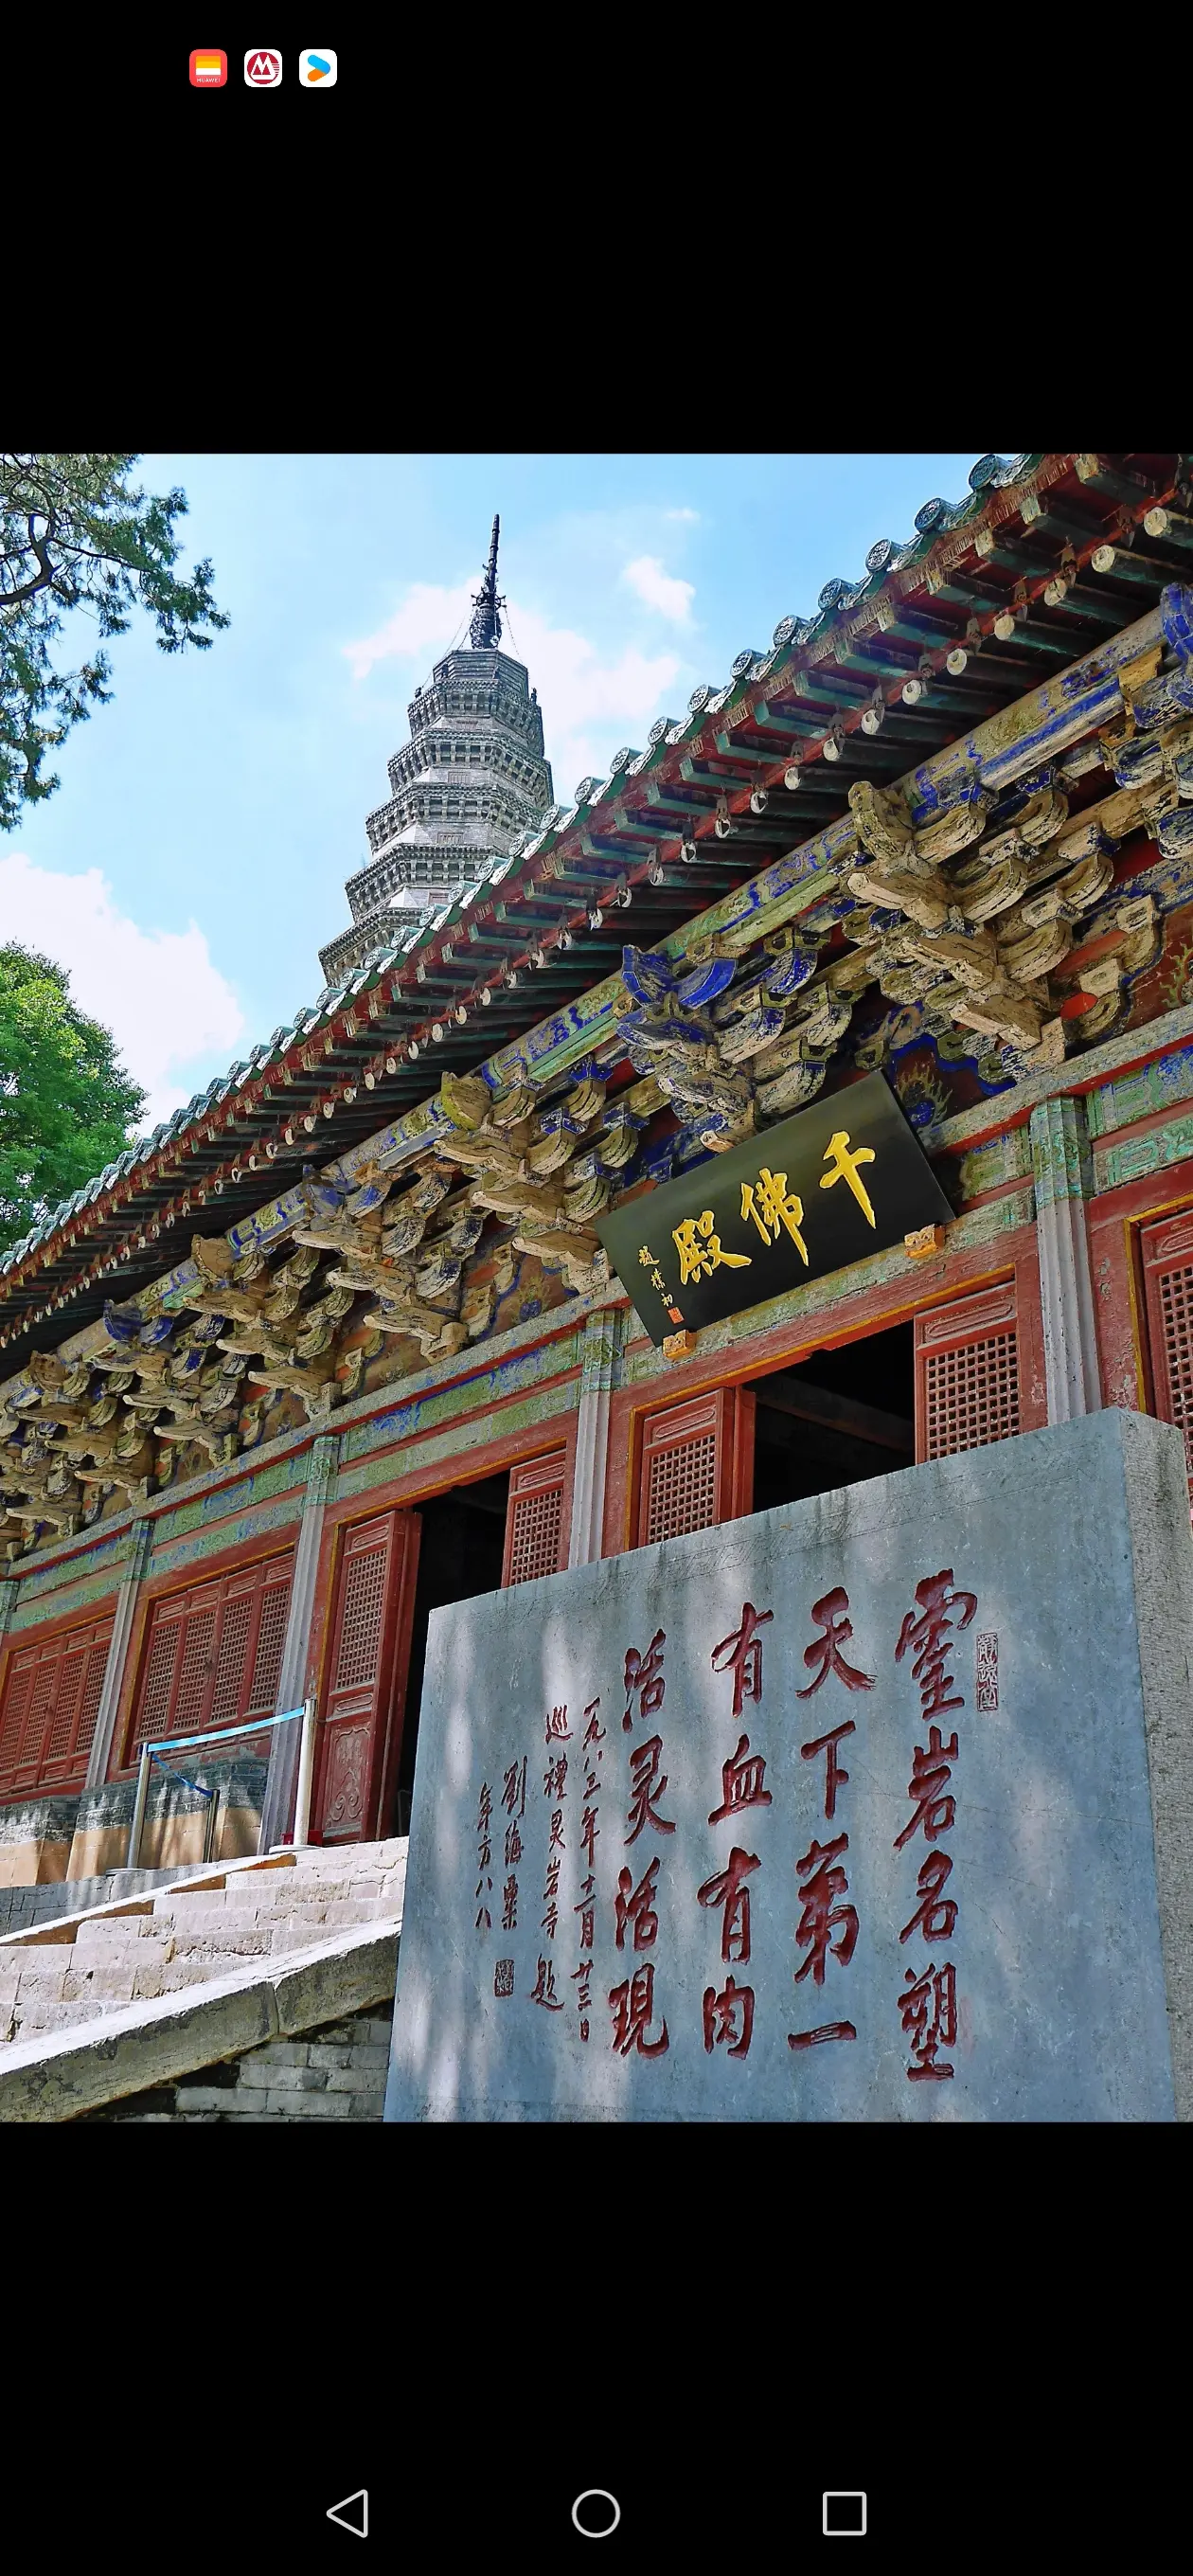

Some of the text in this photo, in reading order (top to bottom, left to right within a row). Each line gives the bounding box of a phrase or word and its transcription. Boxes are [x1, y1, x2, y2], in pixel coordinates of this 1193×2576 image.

[671, 1130, 877, 1286] 千佛殿
[697, 1601, 774, 2060] 有血有肉
[787, 1585, 877, 2049] 天下第一
